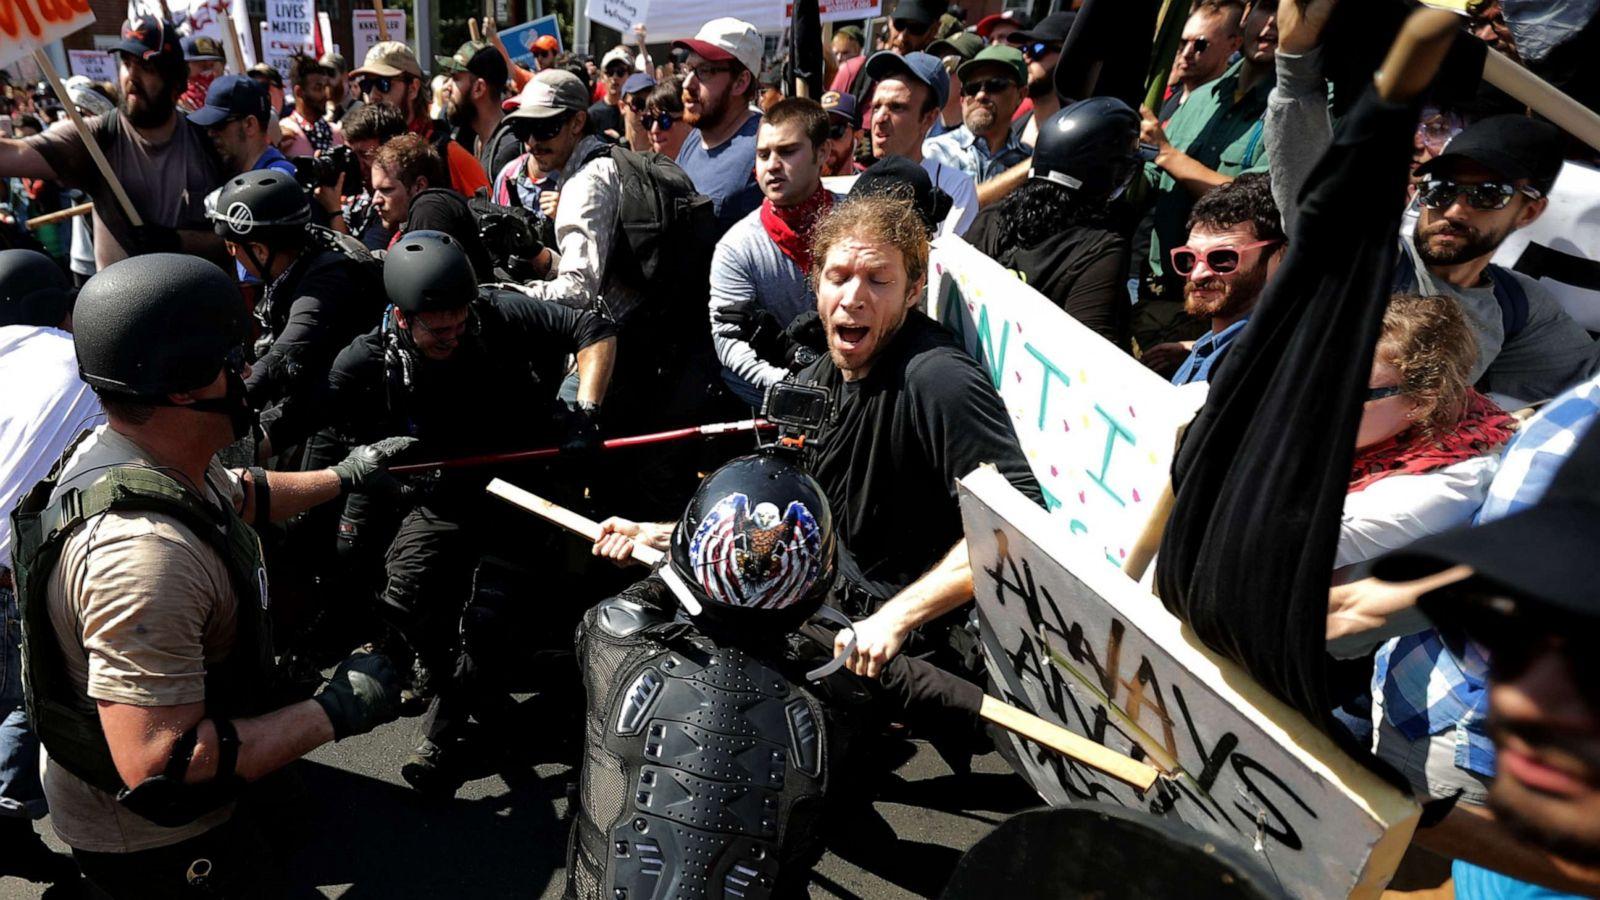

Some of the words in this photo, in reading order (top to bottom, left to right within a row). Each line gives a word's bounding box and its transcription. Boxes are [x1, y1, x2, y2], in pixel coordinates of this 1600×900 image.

[271, 21, 311, 35] MATTER
[275, 4, 305, 18] LIVES
[942, 277, 1136, 507] ANTI
[983, 528, 1318, 851] ALWAYS
